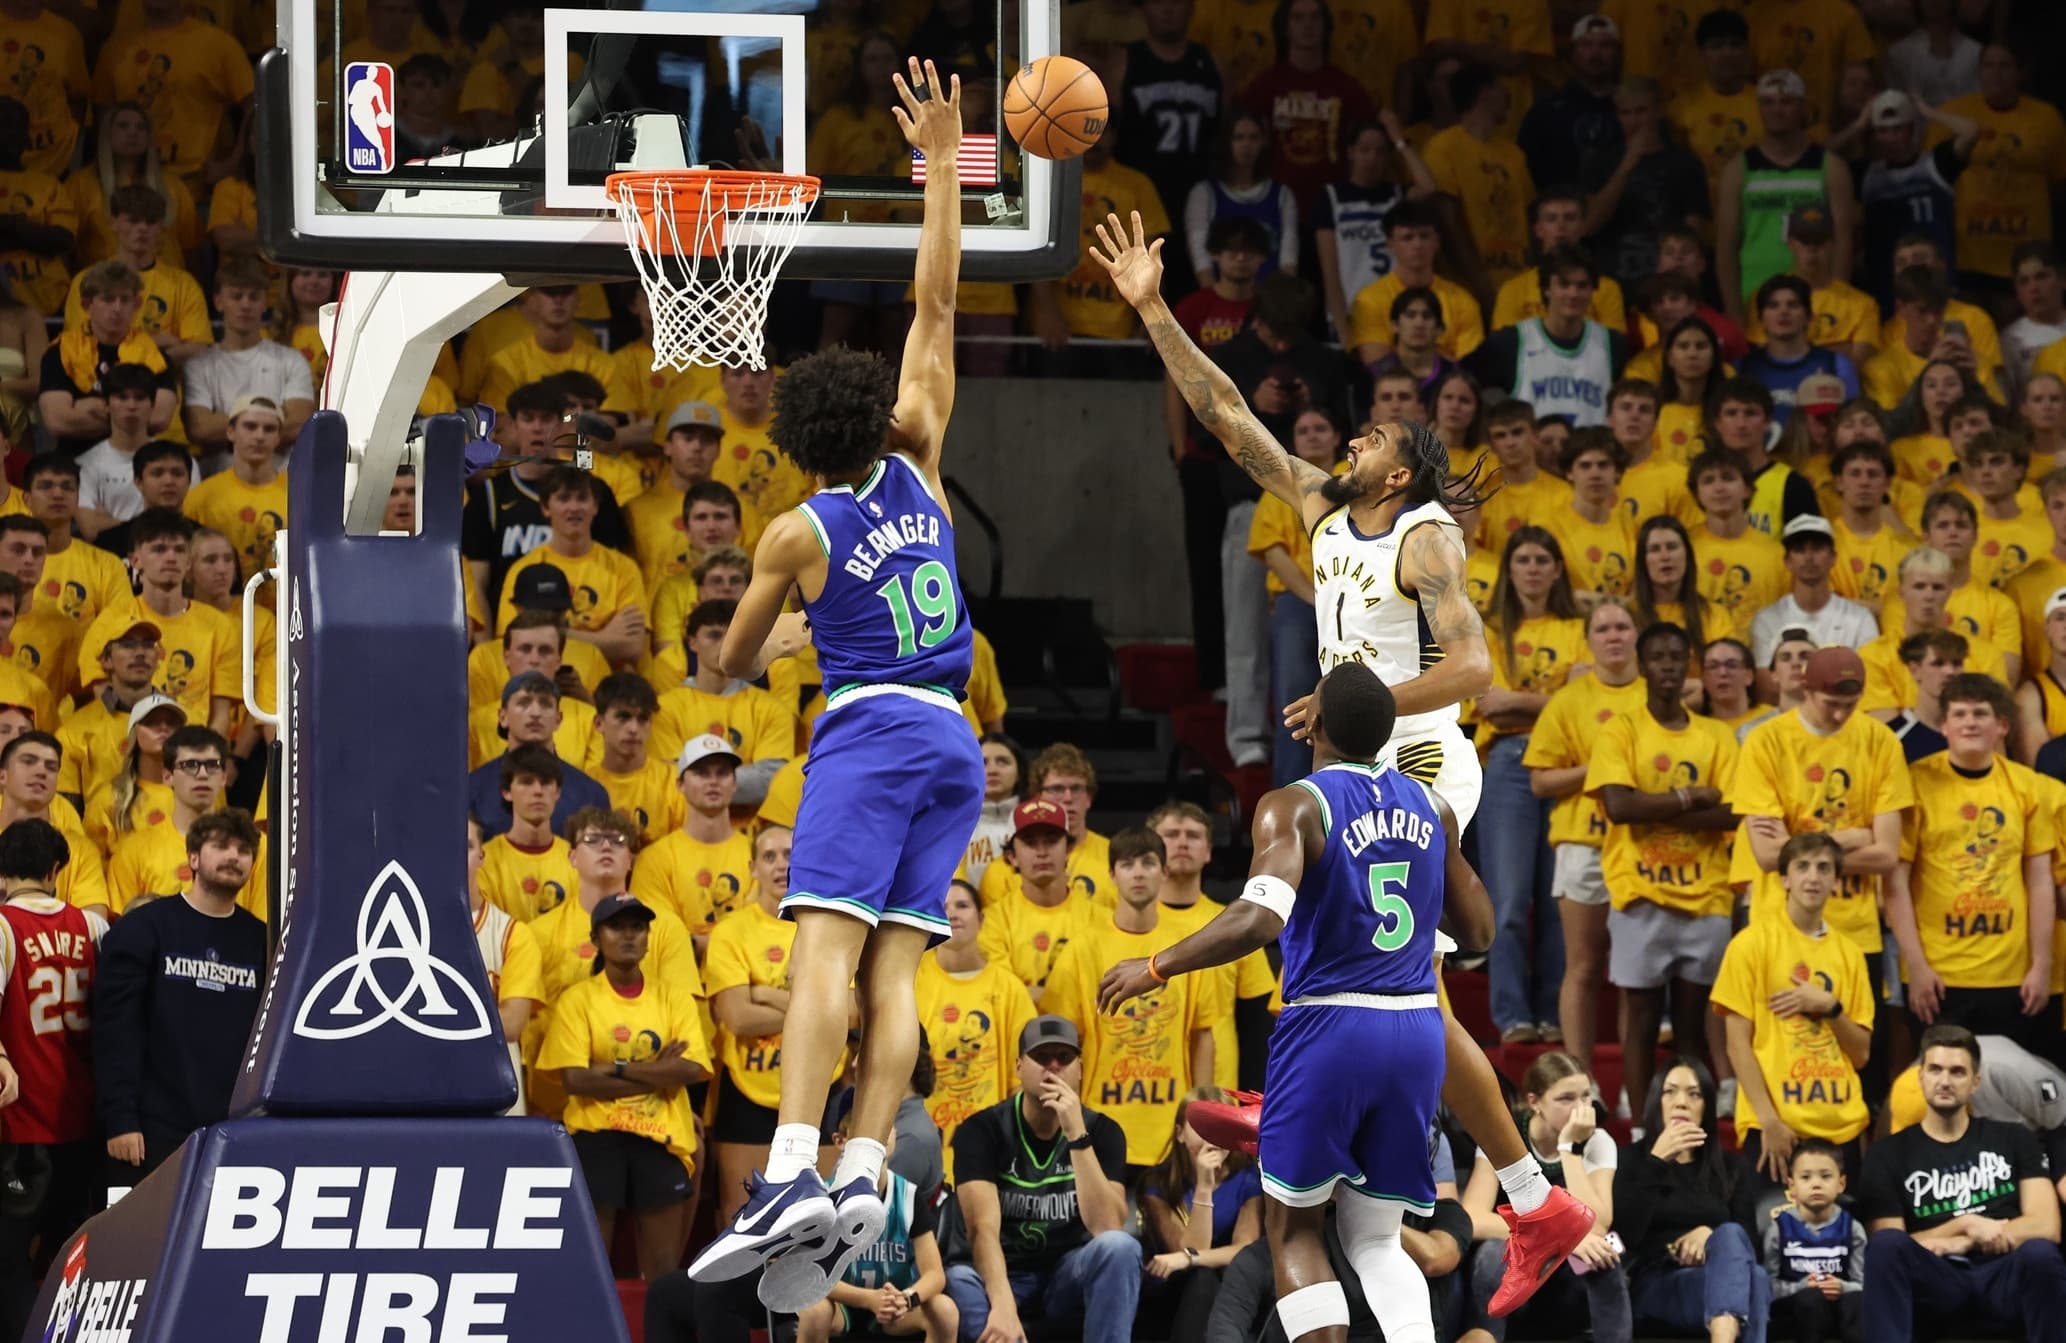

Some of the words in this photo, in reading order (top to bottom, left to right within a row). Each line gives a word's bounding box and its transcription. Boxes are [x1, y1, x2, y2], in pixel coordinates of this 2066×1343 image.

[1154, 109, 1201, 153] 21
[353, 148, 376, 166] NBA
[1908, 196, 1934, 224] 11
[1370, 243, 1391, 274] 5
[502, 524, 554, 557] IND
[1315, 556, 1381, 609] NDIANA
[876, 561, 957, 658] 19
[1336, 591, 1345, 641] 1
[291, 656, 301, 857] Ascension
[970, 837, 994, 864] WA
[1342, 808, 1434, 858] EDWARDS
[1637, 862, 1702, 886] HALI
[1369, 861, 1415, 951] 5
[1945, 908, 2014, 938] HALI
[165, 956, 256, 988] MINNESOTA
[28, 966, 90, 1036] 25
[247, 920, 291, 1073] Vincent
[745, 1049, 784, 1071] HA
[1101, 1078, 1176, 1105] HALI
[1783, 1079, 1851, 1104] HALI
[1904, 1151, 2012, 1209] Playoffs
[201, 1166, 573, 1249] BELLE
[1002, 1190, 1077, 1222] MBERWOLVE
[76, 1279, 147, 1343] BELLE
[244, 1273, 518, 1343] TIRE
